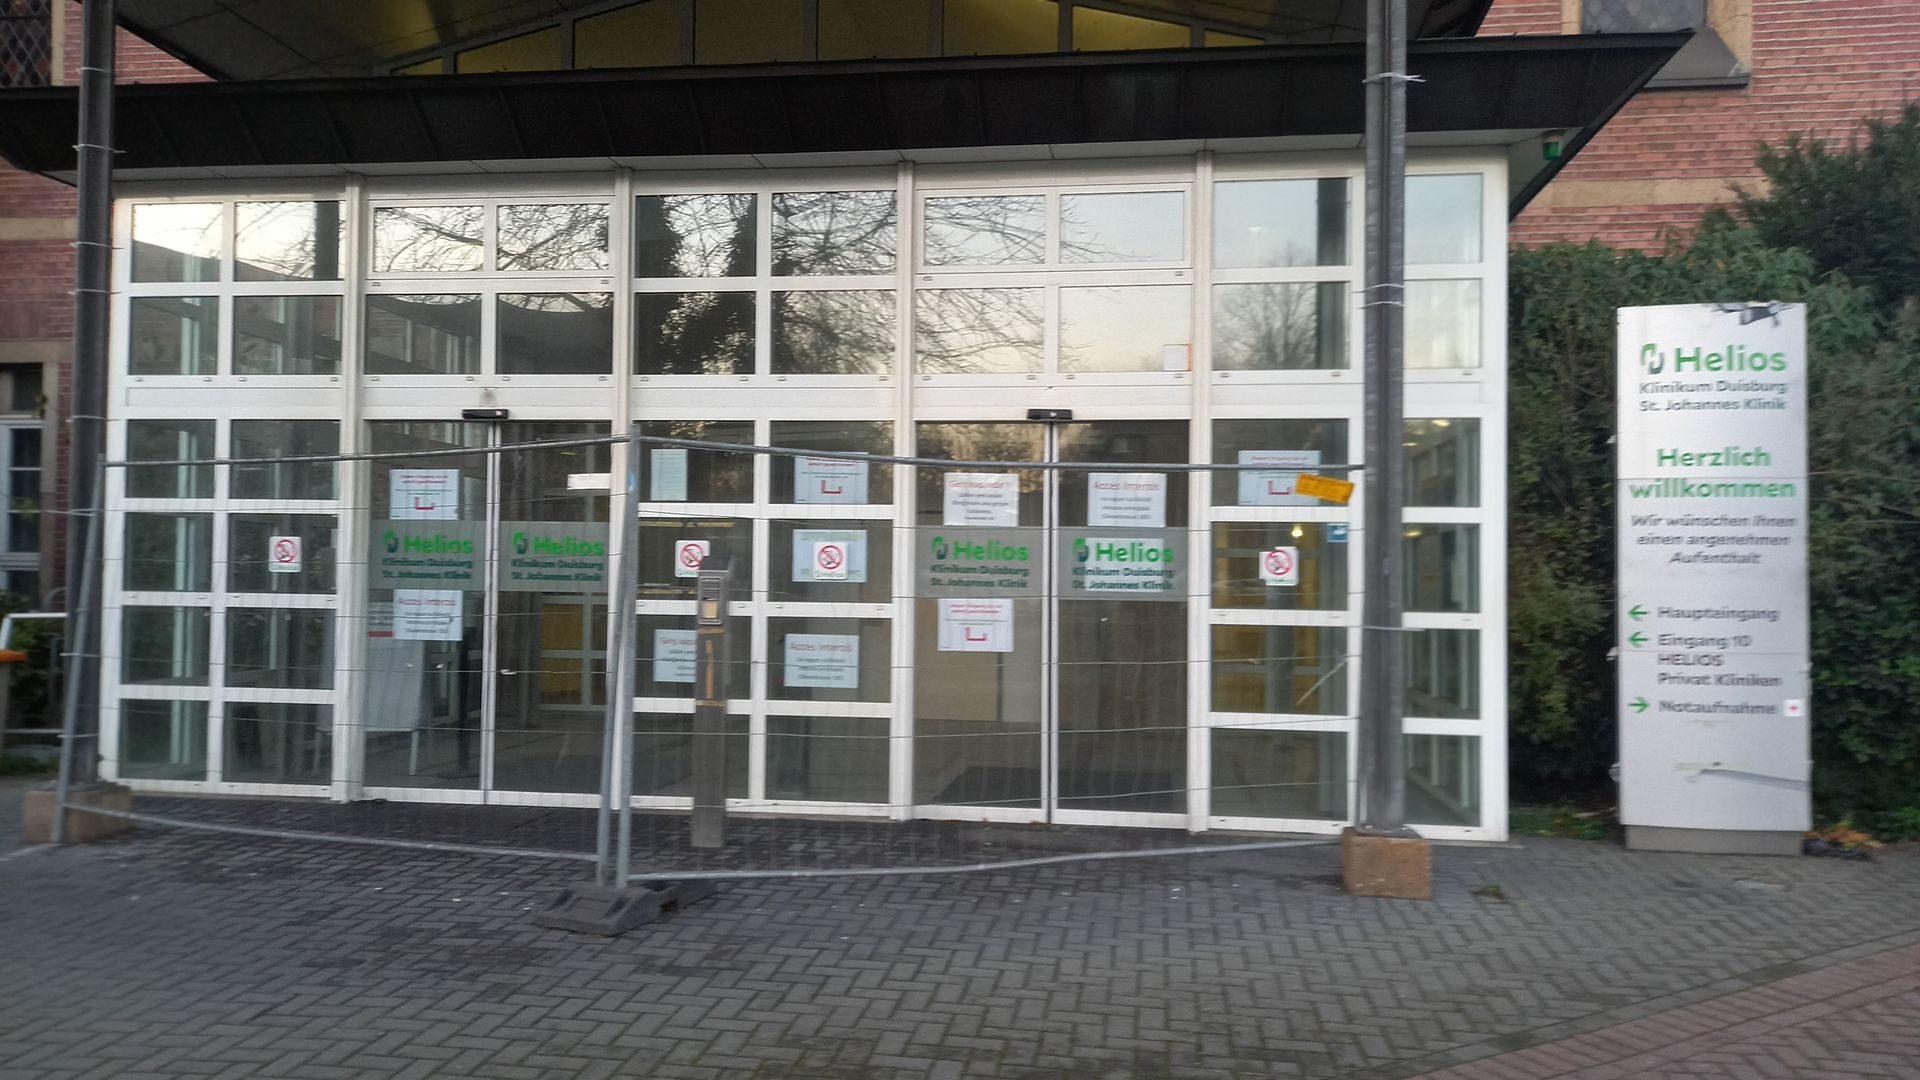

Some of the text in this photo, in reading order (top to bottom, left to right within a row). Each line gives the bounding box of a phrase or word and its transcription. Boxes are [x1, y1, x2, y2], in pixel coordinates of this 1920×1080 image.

[1673, 344, 1788, 372] Helios
[1639, 380, 1788, 395] Klinikum Duisburg
[1639, 398, 1787, 412] St. Johannes Klinik
[1656, 446, 1772, 467] Herzlich
[1629, 477, 1797, 498] willkommen
[1631, 513, 1797, 527] Wir wünschen Ihnen
[402, 533, 474, 554] Helios
[532, 534, 604, 556] Helios
[1637, 533, 1791, 548] einen angenehmen
[953, 540, 1029, 561] Helios
[1095, 542, 1175, 563] Helios
[1669, 551, 1762, 565] Aufenthalt
[930, 564, 1029, 577] Klinikum Duisburg
[1072, 566, 1175, 578] Klinikum Duisburg
[946, 577, 995, 587] Johannes
[998, 578, 1028, 588] Klinik
[1088, 580, 1139, 589] Johannes
[1142, 580, 1174, 589] Klinik
[1657, 606, 1780, 622] Haupteingang
[1658, 633, 1753, 649] Eingang 10
[1657, 653, 1724, 666] HELIOS
[1657, 672, 1782, 686] Privat Kliniken
[1658, 700, 1778, 714] Notaufnahme
